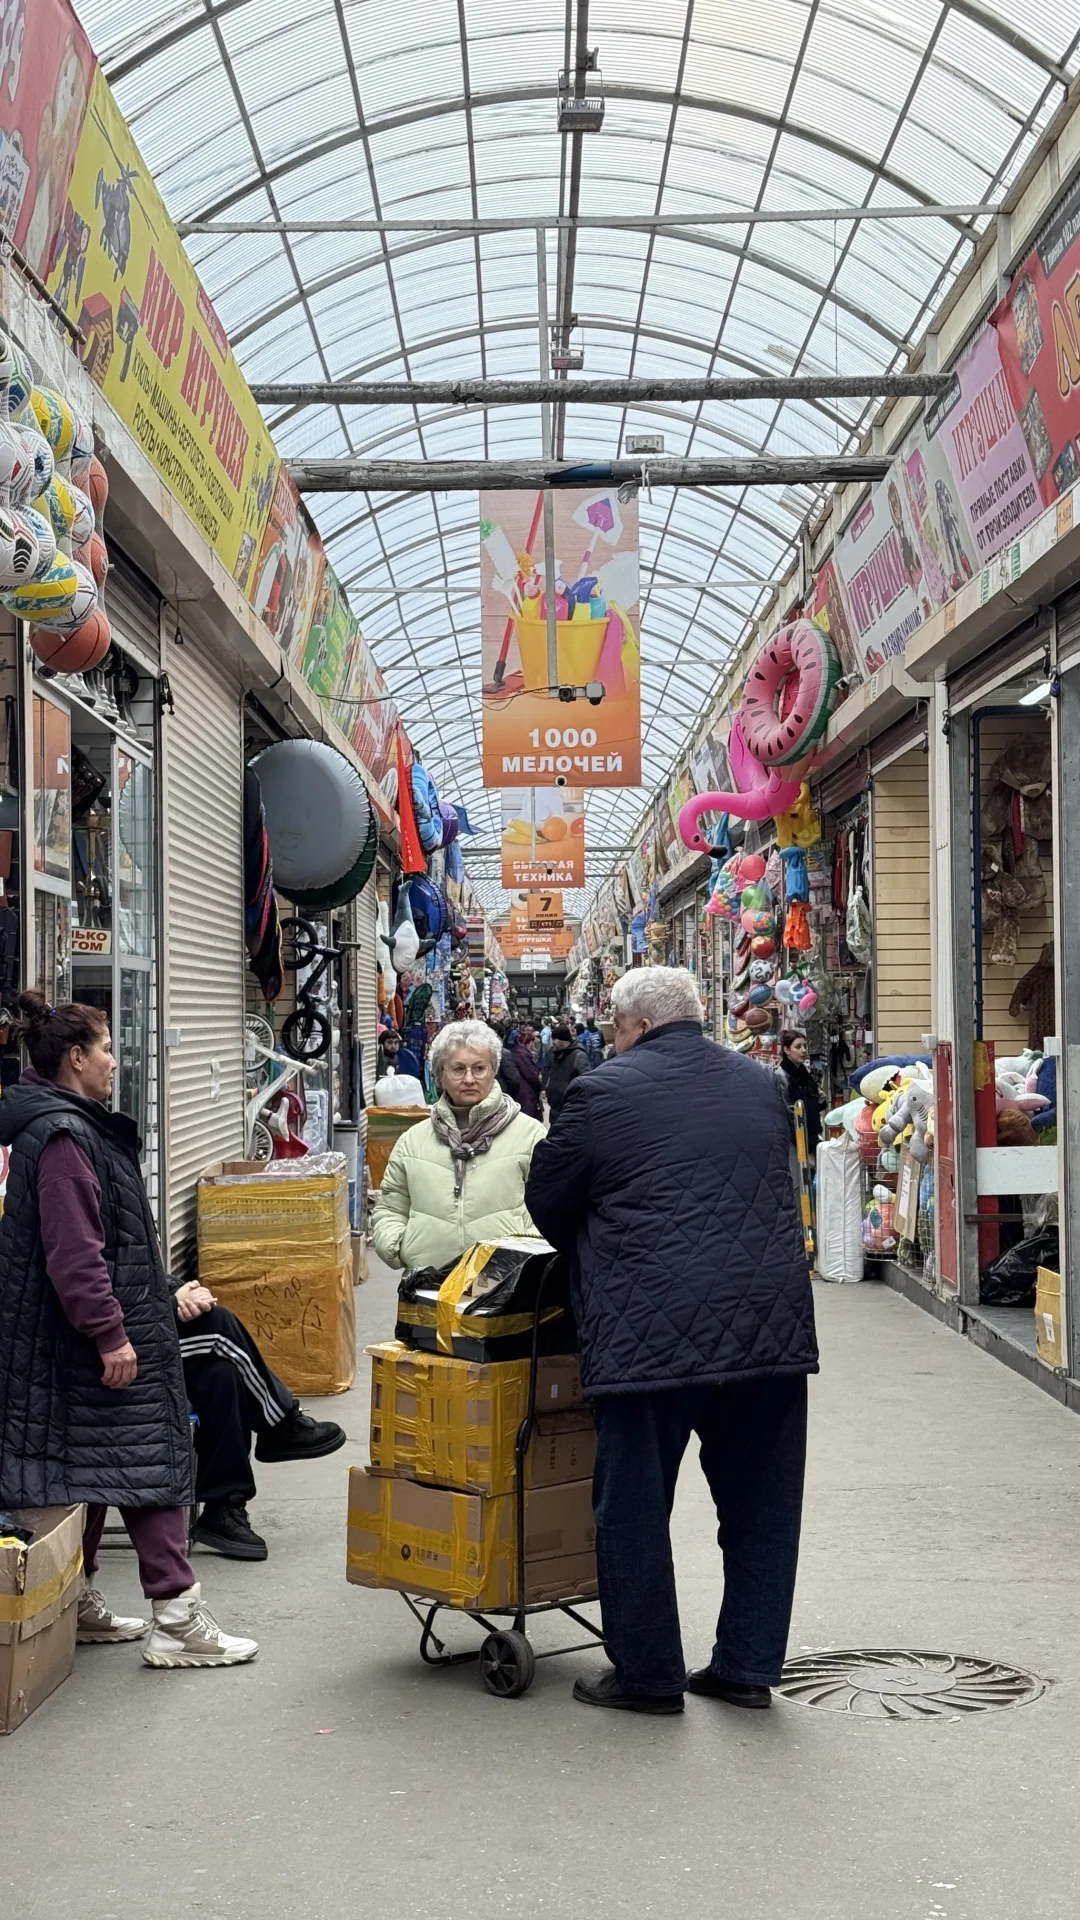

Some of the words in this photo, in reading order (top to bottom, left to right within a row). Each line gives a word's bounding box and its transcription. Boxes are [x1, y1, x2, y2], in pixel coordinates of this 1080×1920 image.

[138, 245, 185, 371] МИР
[132, 349, 150, 396] КУКЛЫ
[150, 381, 180, 438] МАШИНЫ
[180, 325, 249, 494] ИГРУШЕК
[952, 369, 1016, 483] ИГРУШКИ
[133, 402, 159, 456] РОБОТЫ
[158, 443, 196, 510] КОНСТРУКТОРЫ
[970, 482, 994, 524] ПРЯМЫЕ
[993, 453, 1028, 501] ПОСТАВКИ
[976, 530, 987, 551] ОТ
[985, 482, 1038, 547] ПРОИЗВОДИТЕЛЯ
[847, 525, 909, 638] ИГРУШКИ
[502, 751, 623, 773] МЕЛОЧЕЙ
[529, 728, 597, 748] 1000
[513, 872, 574, 882] ТЕХНИКА
[540, 897, 552, 911] 7
